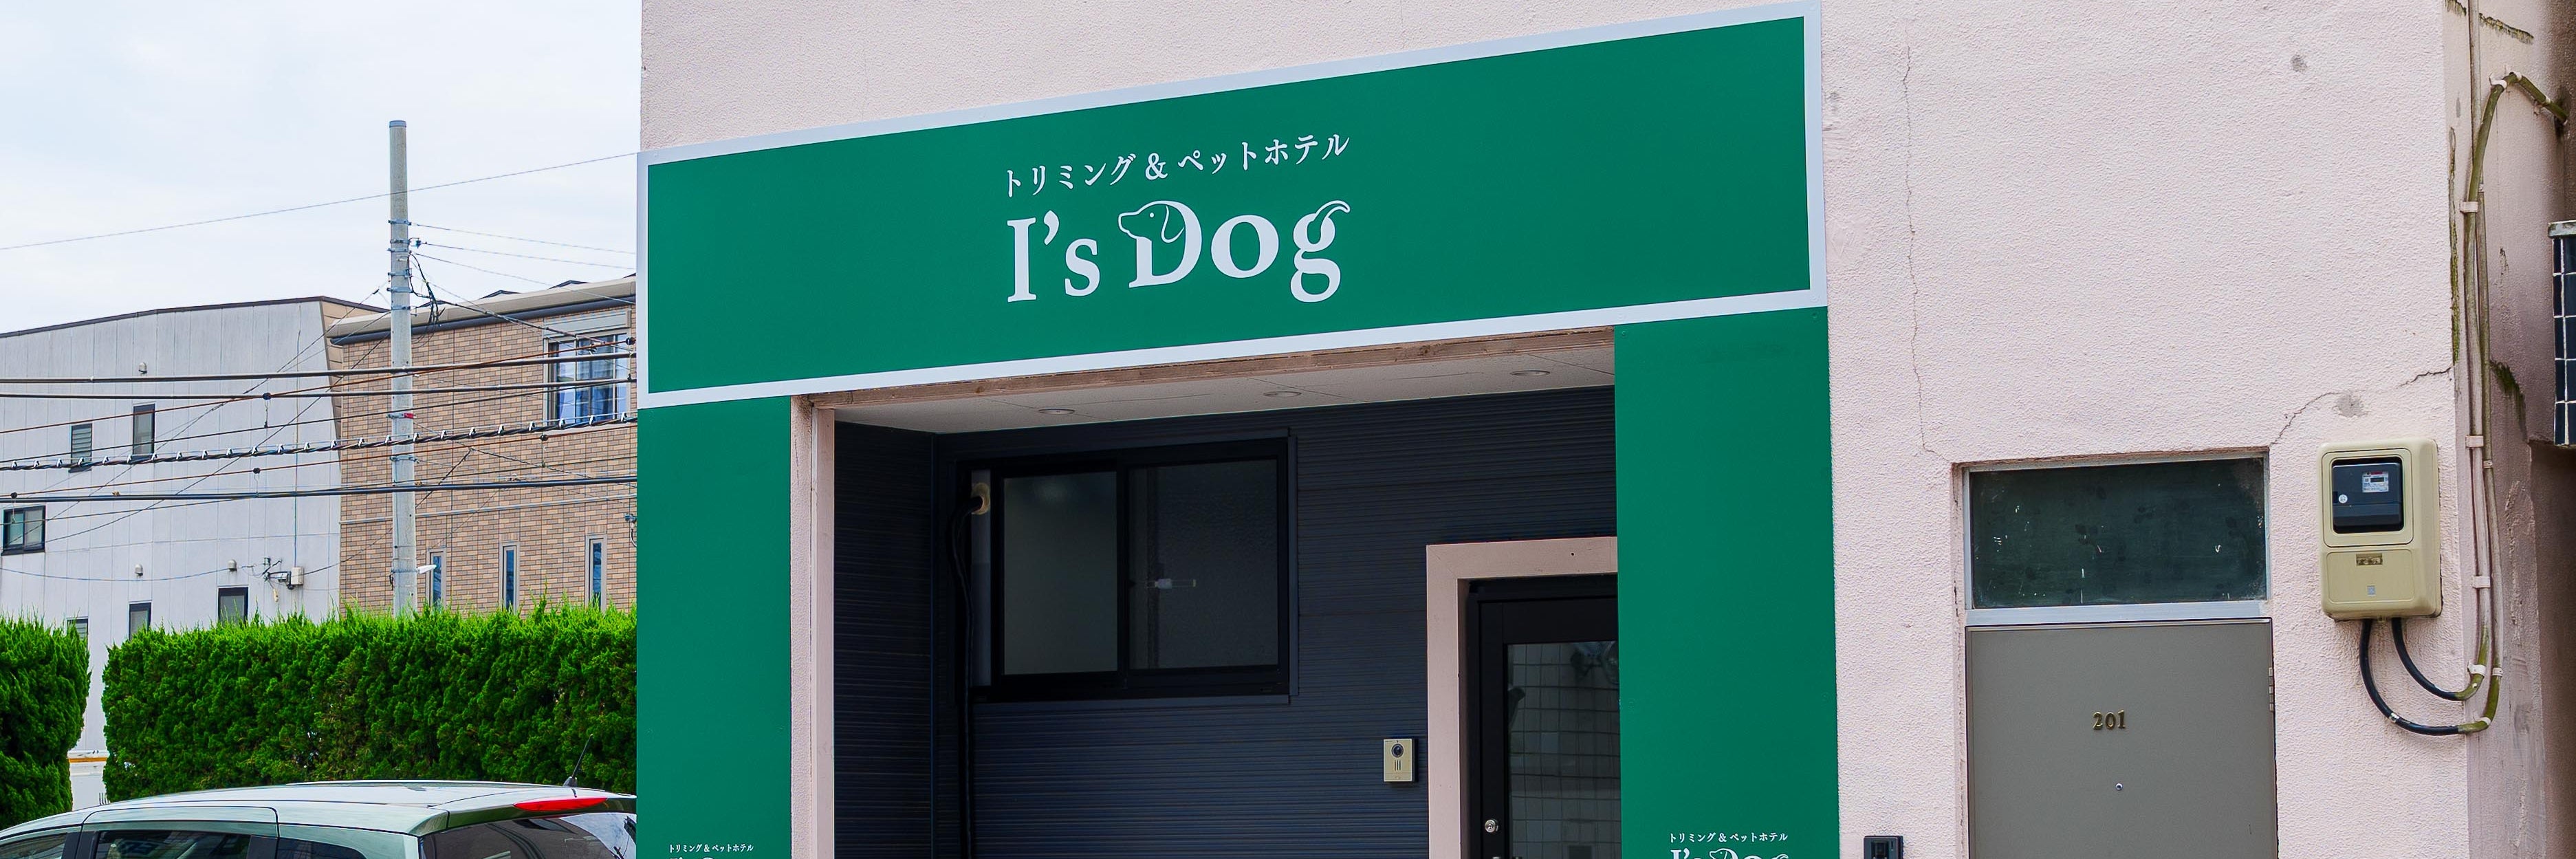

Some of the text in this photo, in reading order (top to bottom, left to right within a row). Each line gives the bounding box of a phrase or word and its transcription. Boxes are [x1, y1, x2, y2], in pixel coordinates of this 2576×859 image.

[1007, 133, 1350, 198] トリミング & ペットホテル
[1007, 199, 1351, 303] I's Dog
[2093, 709, 2126, 730] 201
[670, 843, 754, 853] トリミング & ペットホテル
[1670, 832, 1788, 843] トリミング & ペットホテル
